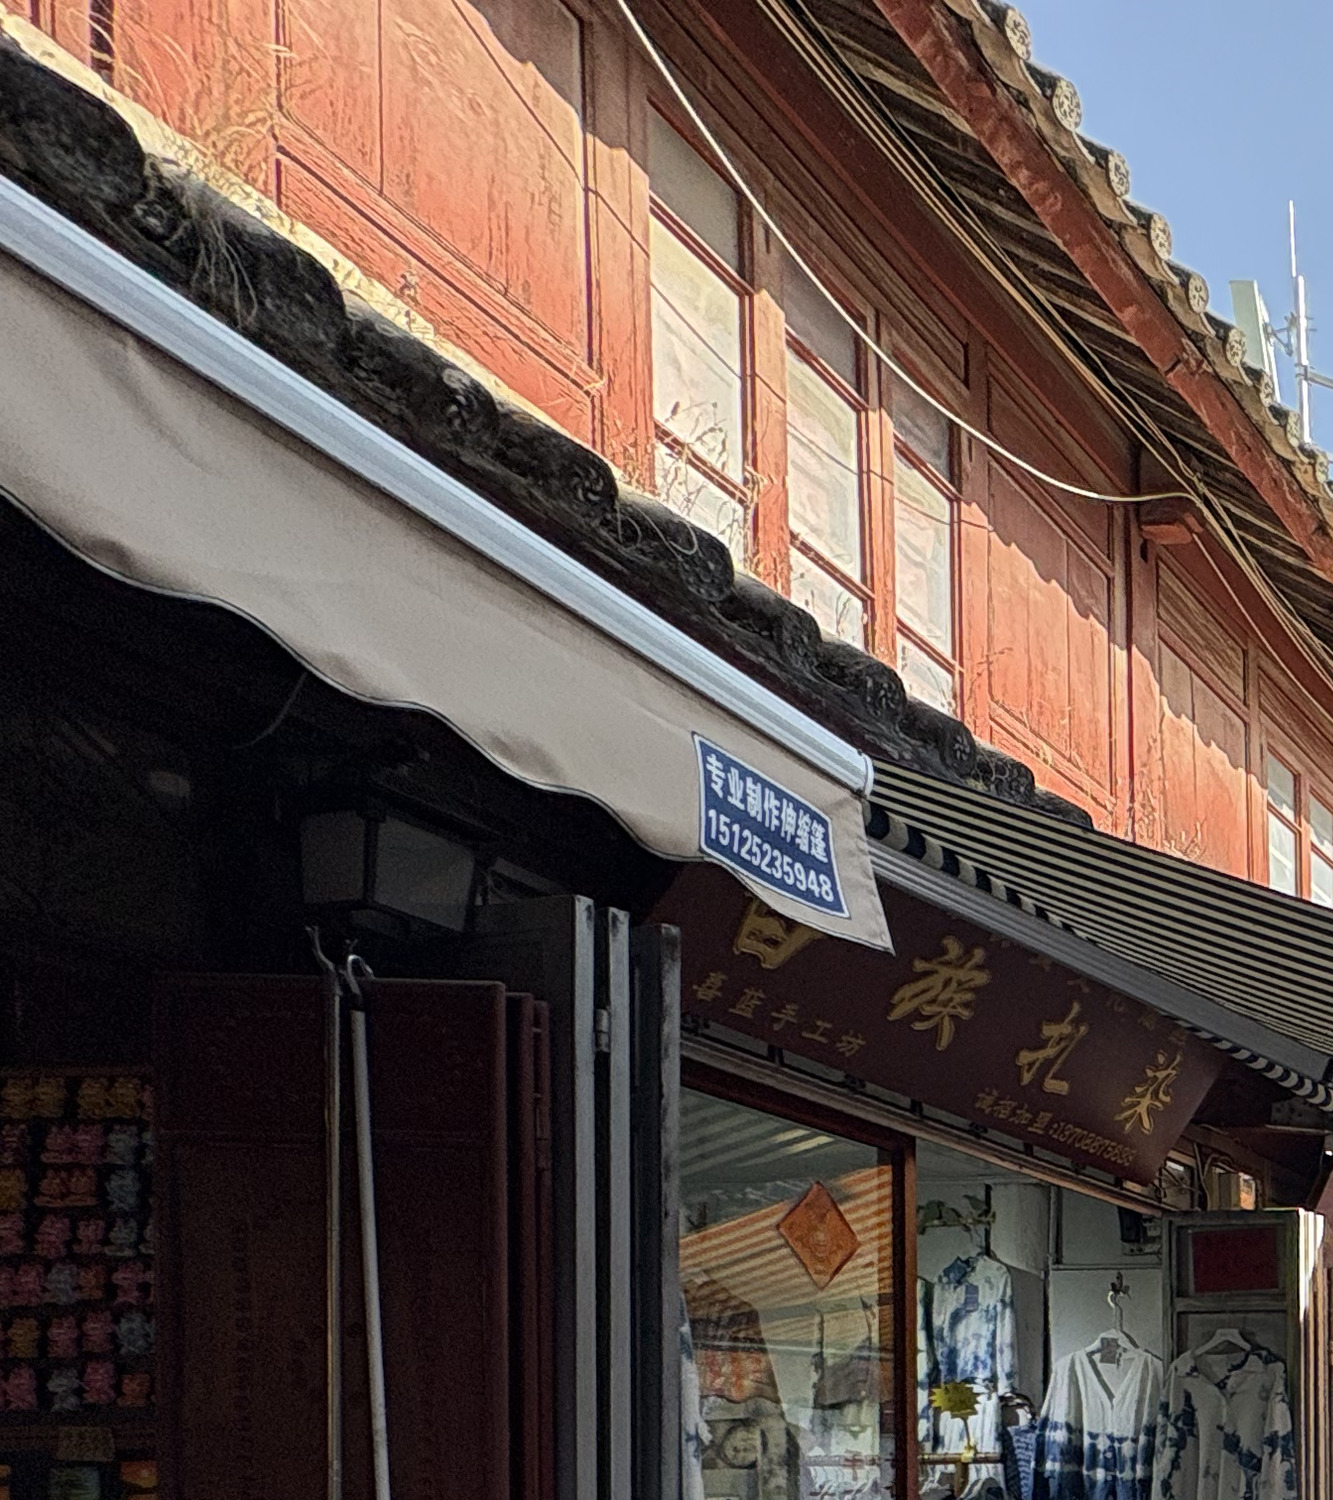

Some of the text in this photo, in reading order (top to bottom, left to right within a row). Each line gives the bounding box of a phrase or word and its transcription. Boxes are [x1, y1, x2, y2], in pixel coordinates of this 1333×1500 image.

[705, 753, 828, 863] 专业制作伸缩篷
[708, 808, 835, 903] 15125235948
